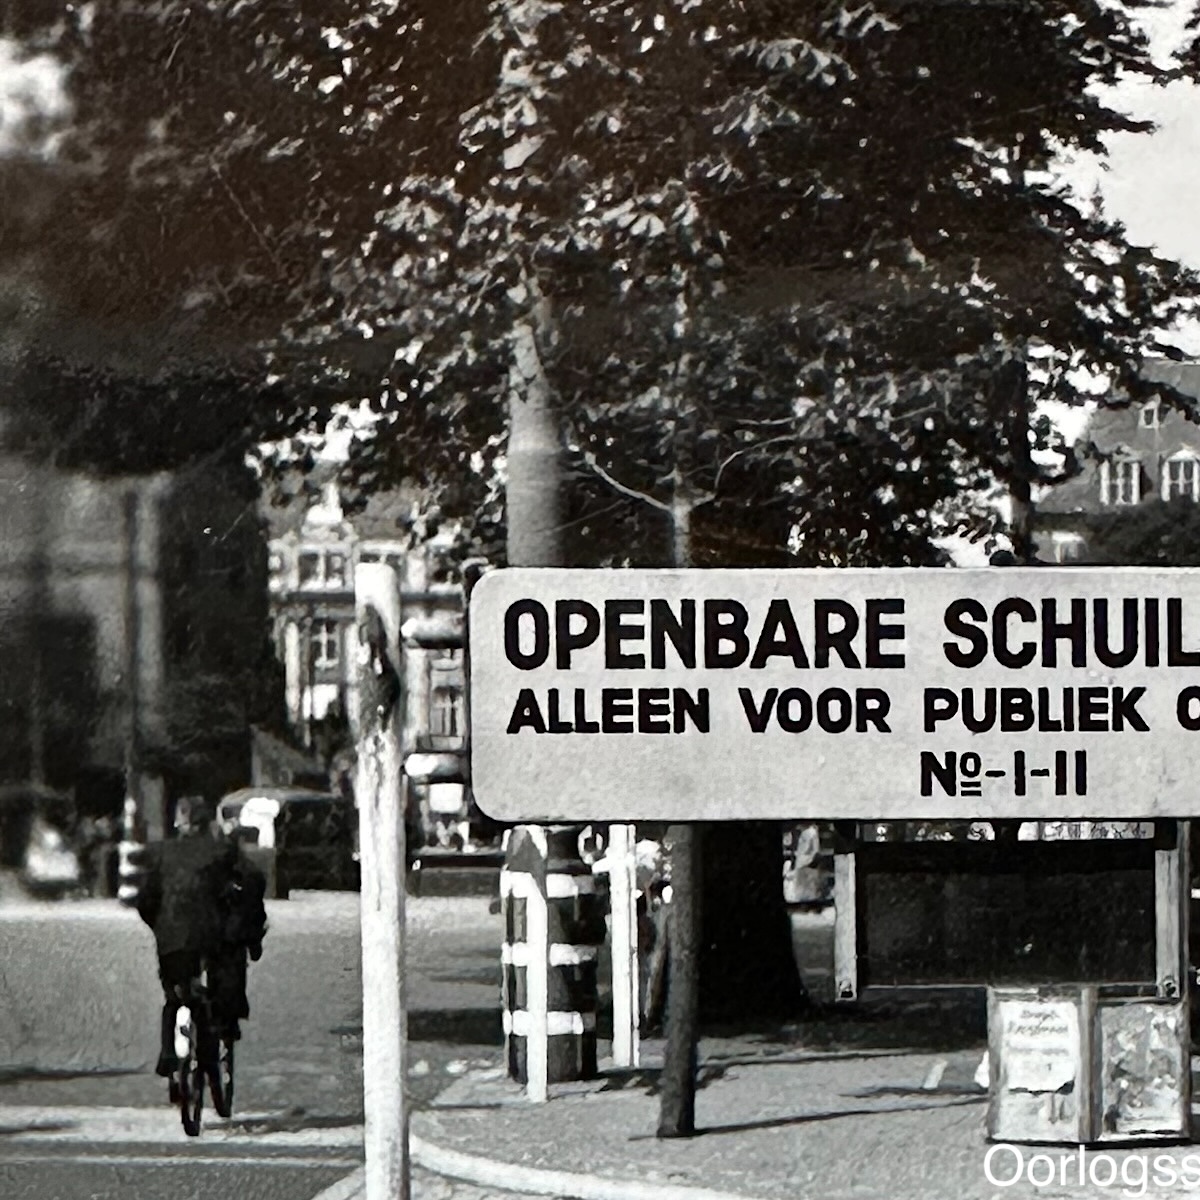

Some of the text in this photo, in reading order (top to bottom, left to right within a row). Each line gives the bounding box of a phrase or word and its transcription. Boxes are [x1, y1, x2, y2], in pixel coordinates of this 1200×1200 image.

[504, 599, 907, 671] OPENBARE
[507, 688, 711, 736] ALLEEN
[738, 688, 893, 735] VOOR
[924, 687, 1151, 735] PUBLIEK
